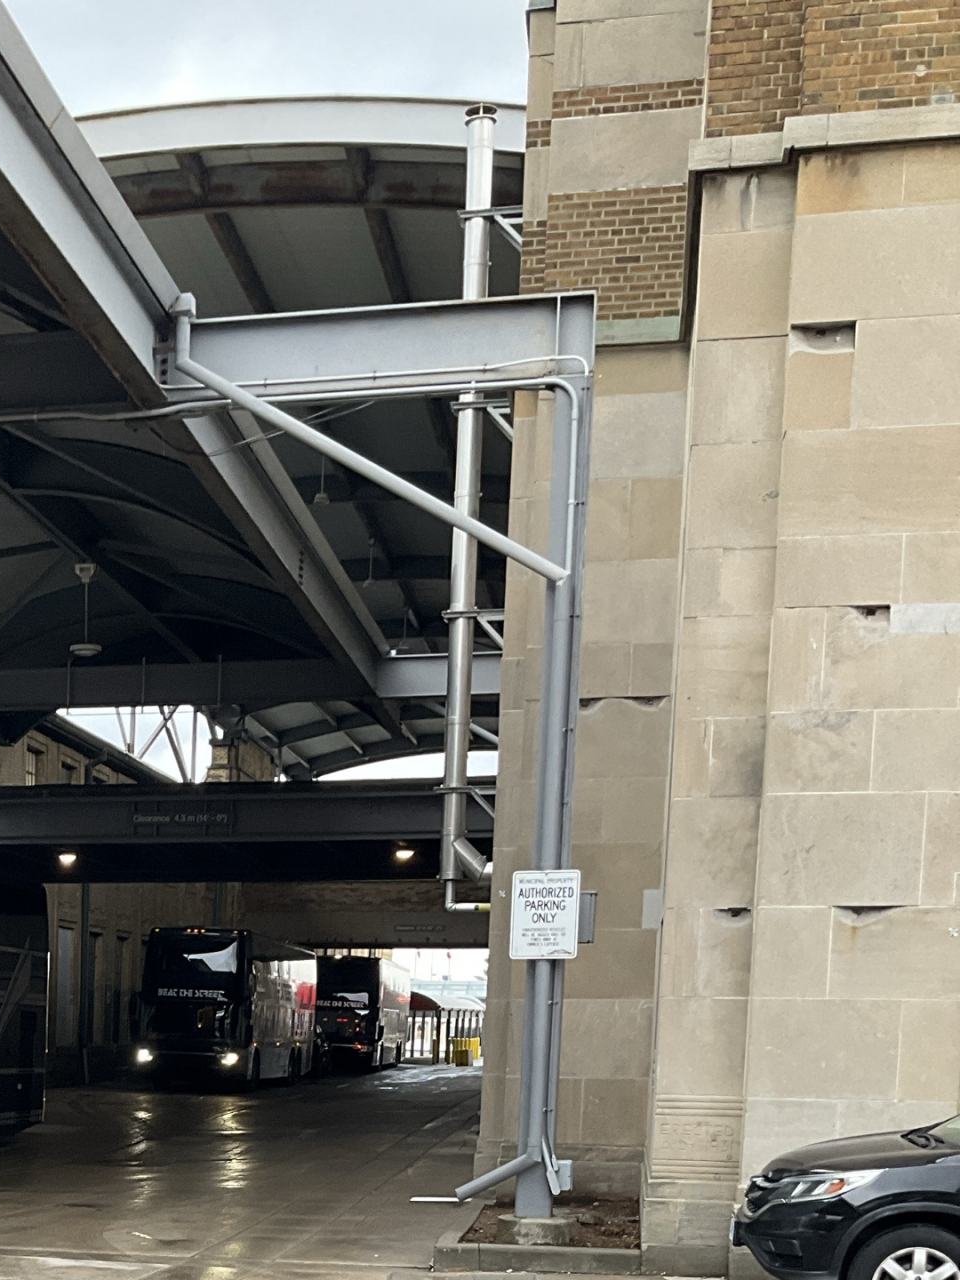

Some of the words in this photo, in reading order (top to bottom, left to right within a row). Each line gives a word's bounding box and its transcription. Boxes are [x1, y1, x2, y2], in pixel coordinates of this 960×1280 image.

[133, 814, 170, 823] Clearance
[174, 814, 186, 822] 4.3
[518, 886, 574, 899] AUTHORIZED
[524, 900, 566, 911] PARKING
[532, 912, 557, 924] ONLY
[157, 988, 178, 997] BEAT
[179, 988, 193, 998] THE
[194, 989, 225, 1000] STREET
[660, 1122, 734, 1137] ERECTED
